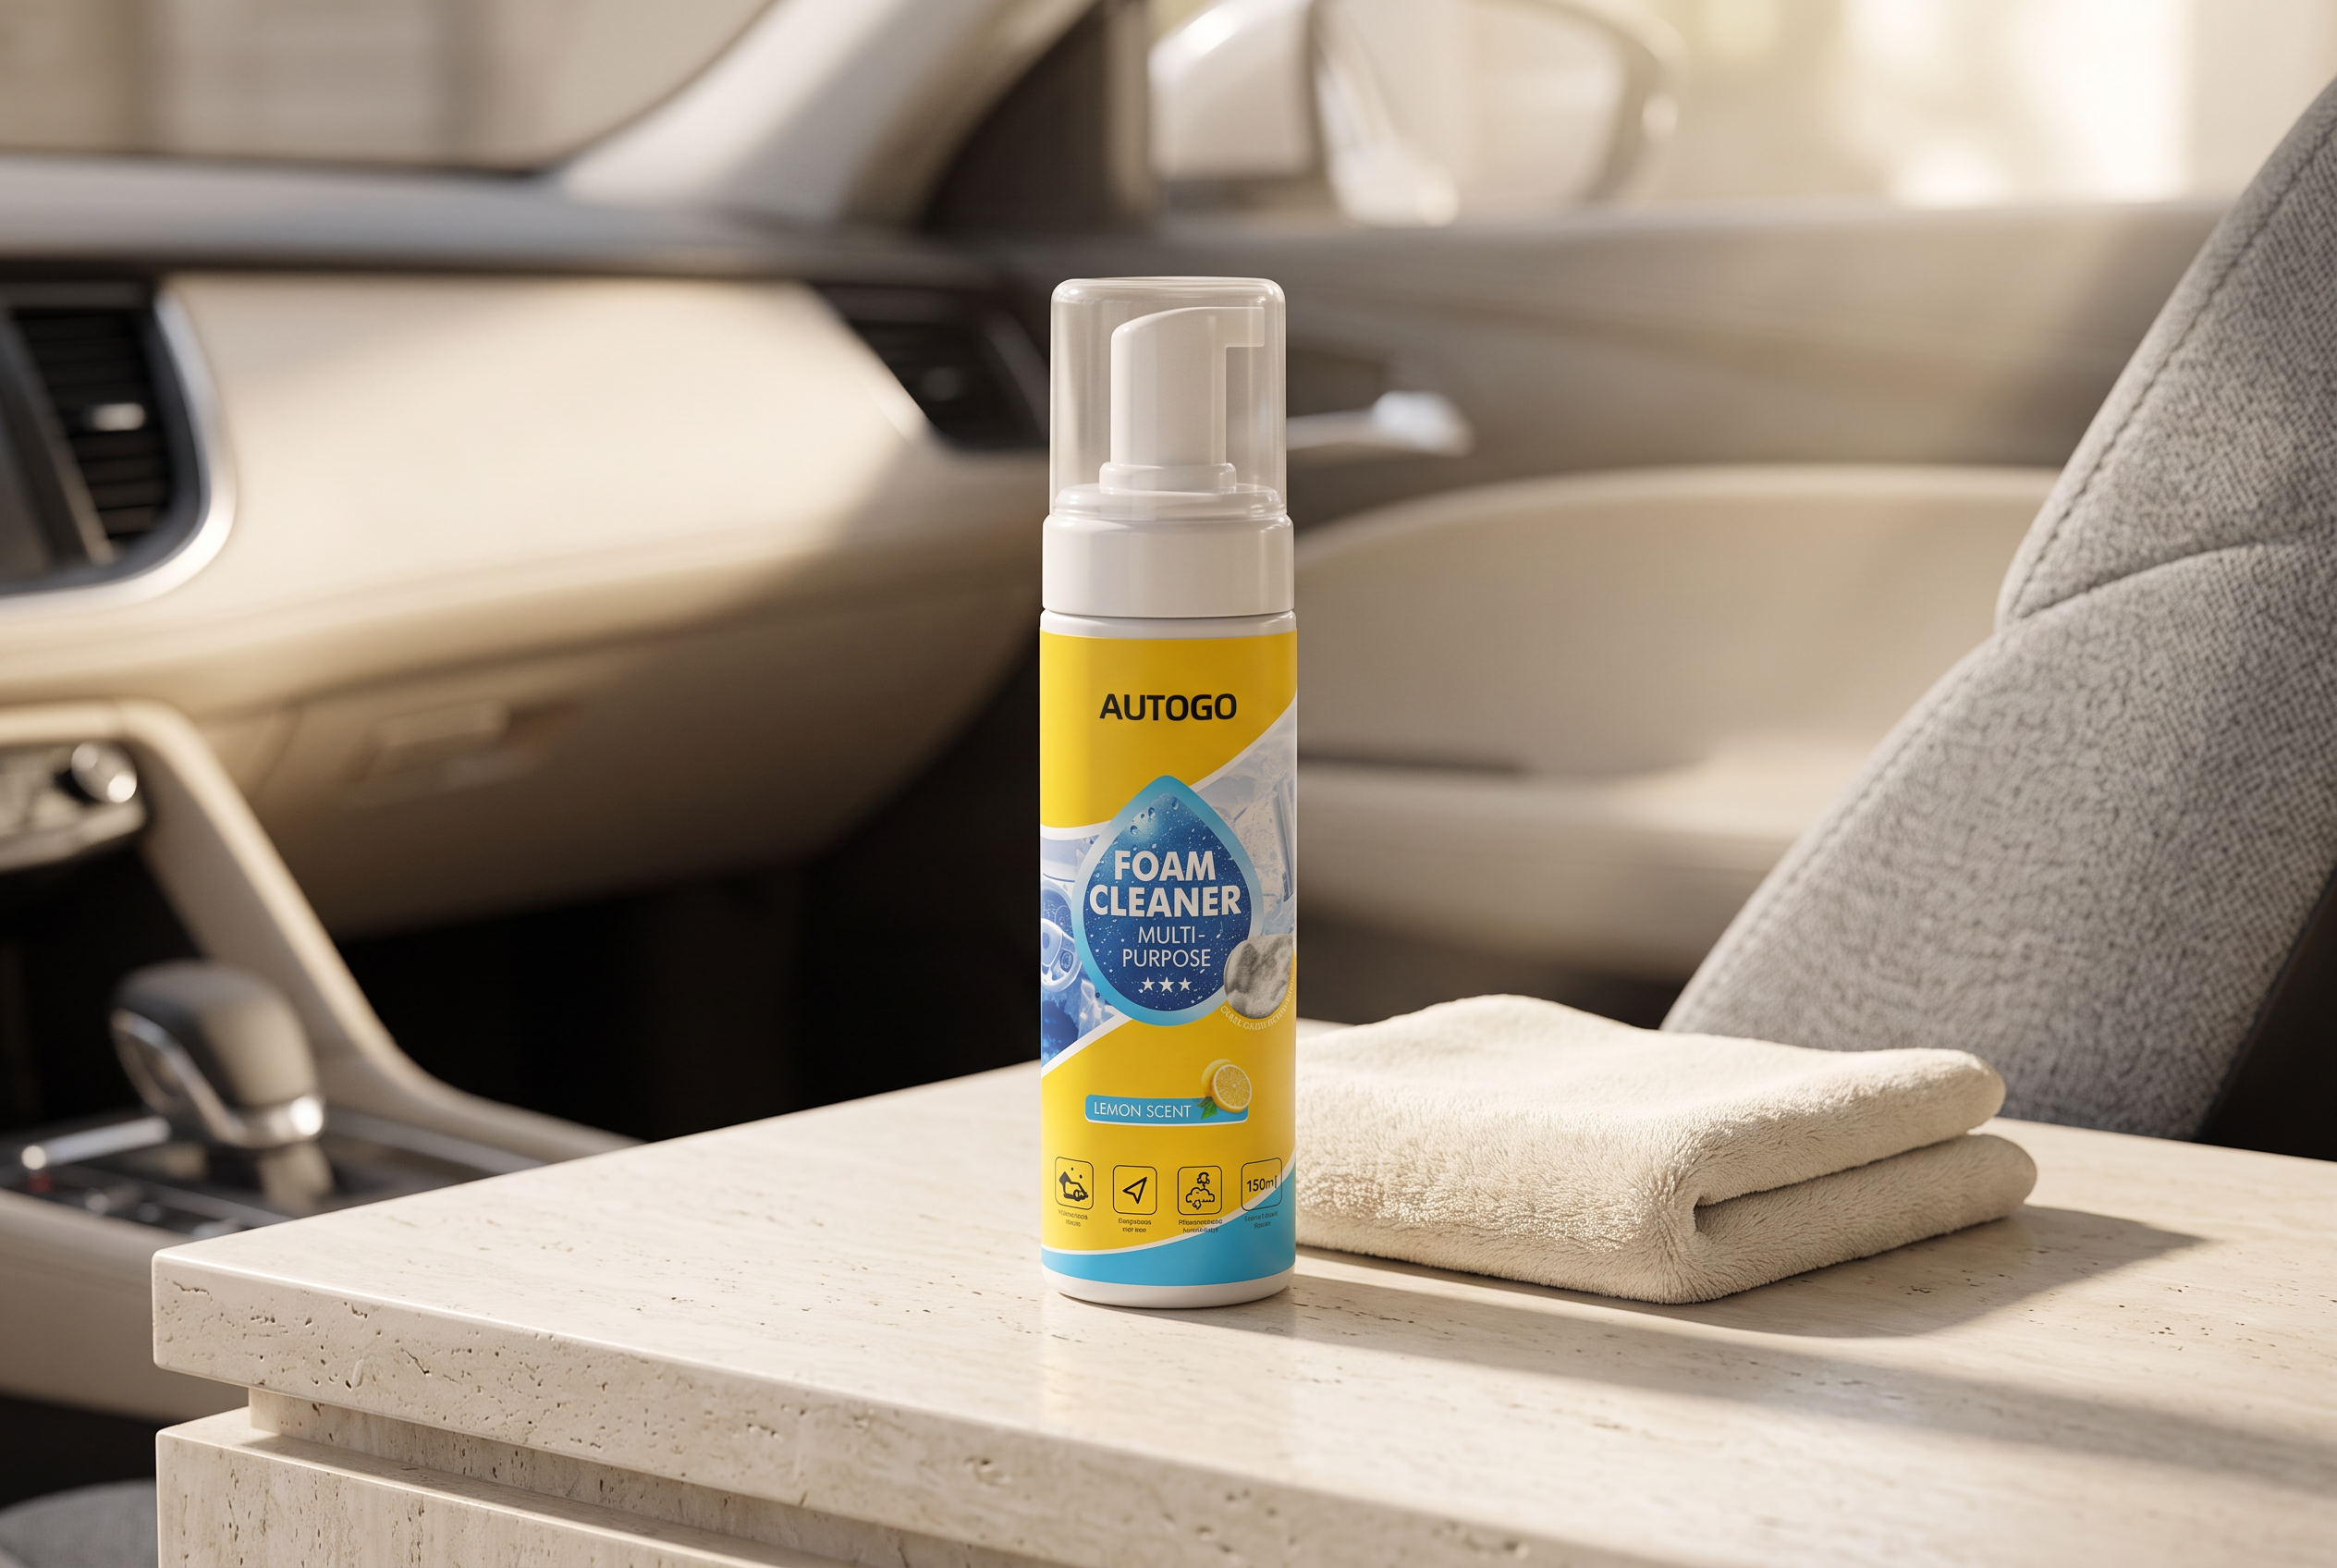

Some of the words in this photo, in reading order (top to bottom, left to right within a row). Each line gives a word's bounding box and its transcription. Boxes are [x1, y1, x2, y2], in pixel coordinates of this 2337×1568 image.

[1099, 693, 1237, 721] AUTOGO
[1114, 850, 1216, 881] FOAM
[1089, 884, 1242, 917] CLEANER
[1138, 925, 1205, 944] MULTI-
[1122, 949, 1211, 968] PURPOSE
[1094, 1101, 1142, 1118] LEMON
[1146, 1105, 1192, 1119] SCENT
[1246, 1175, 1278, 1193] 150ml
